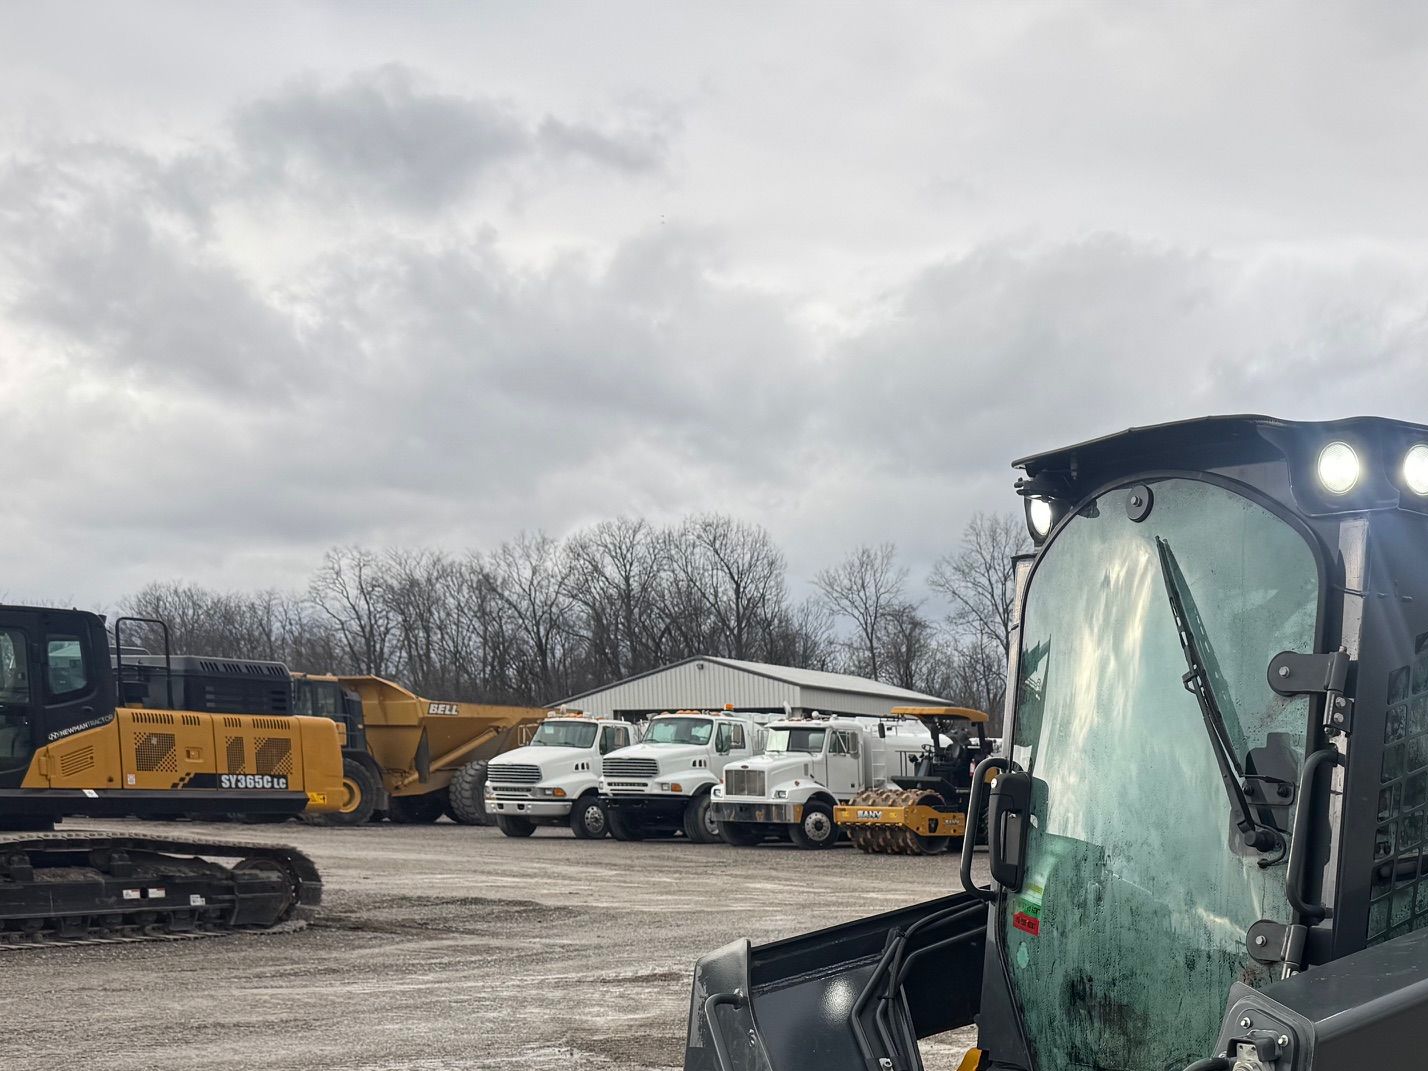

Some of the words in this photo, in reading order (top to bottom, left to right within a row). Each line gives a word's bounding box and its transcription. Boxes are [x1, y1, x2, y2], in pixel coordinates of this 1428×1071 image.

[429, 703, 458, 715] BELL
[221, 775, 272, 788] SY365C
[273, 778, 287, 789] LC
